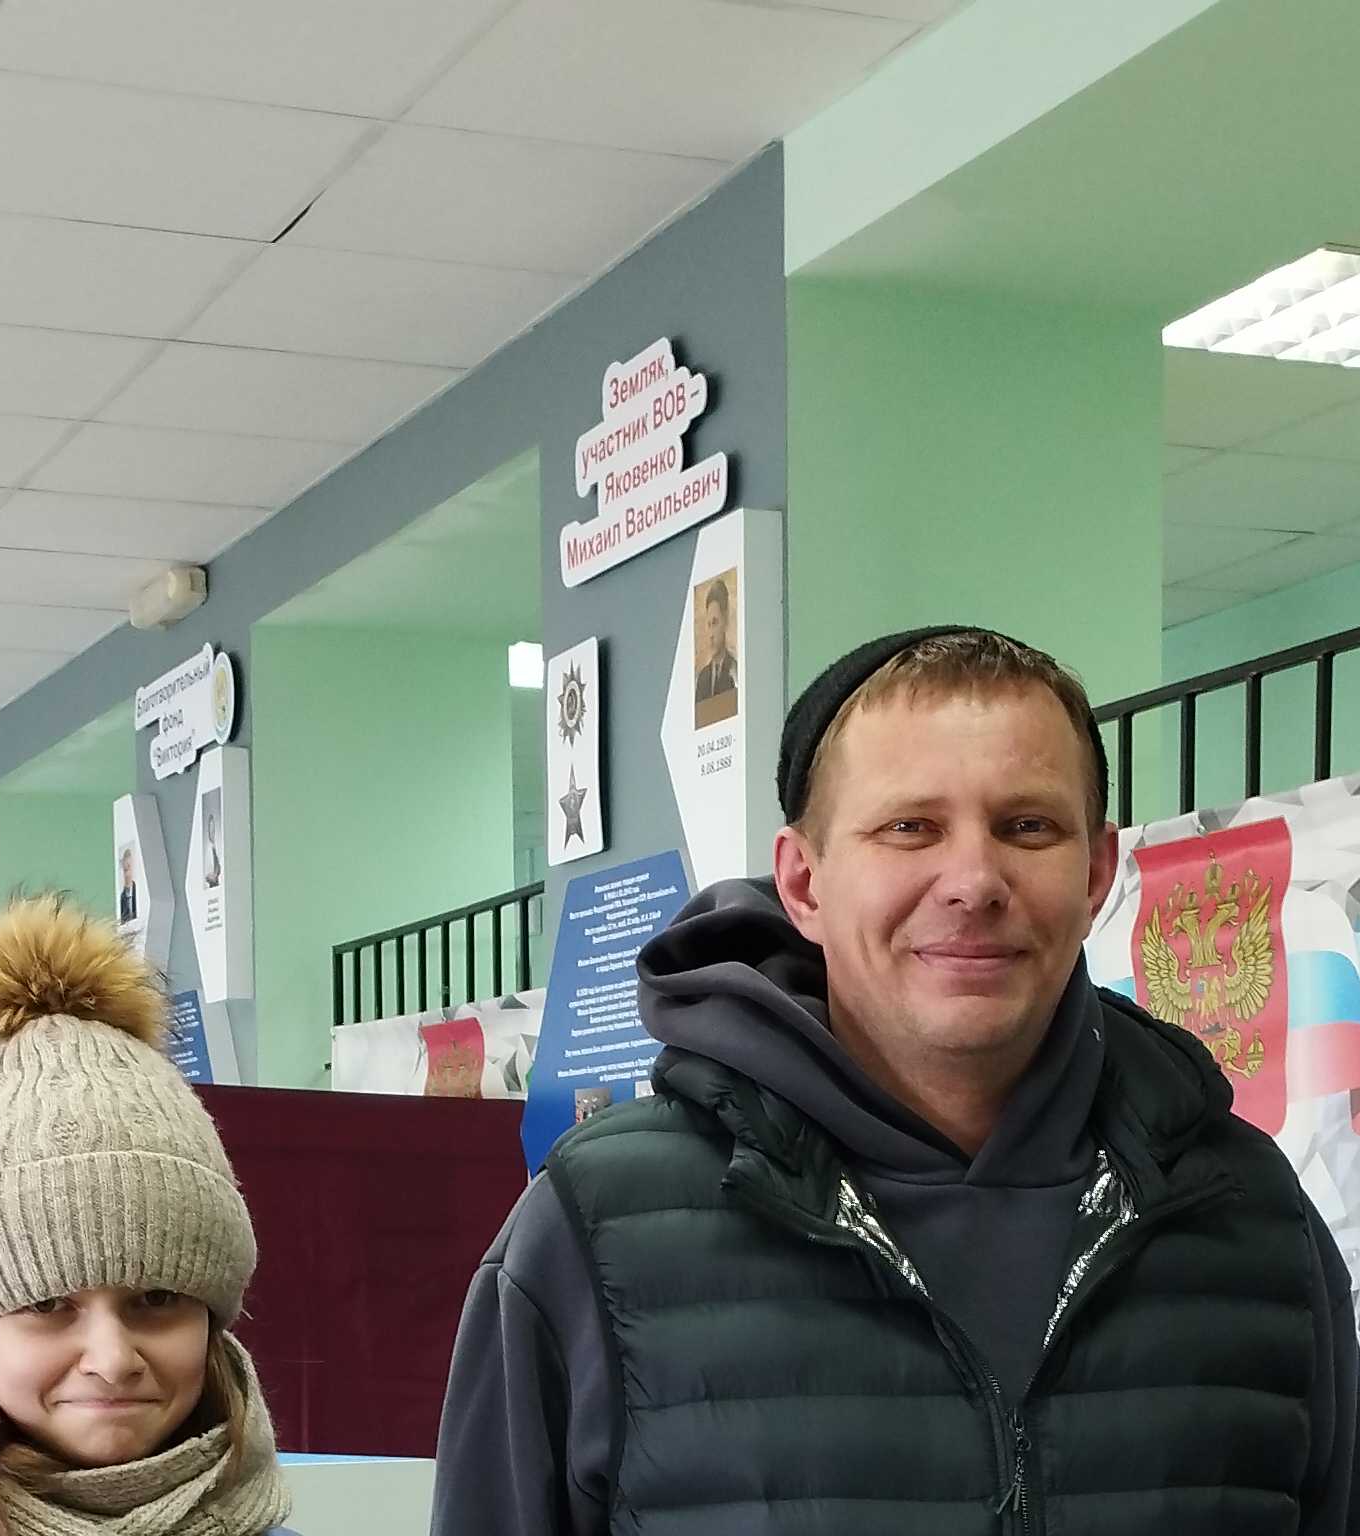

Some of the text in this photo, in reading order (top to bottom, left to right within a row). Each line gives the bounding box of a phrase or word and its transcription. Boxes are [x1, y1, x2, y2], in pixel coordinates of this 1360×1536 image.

[609, 353, 669, 410] Земляк,
[581, 413, 649, 480] участник
[653, 381, 686, 428] ВОВ
[604, 445, 677, 505] Яковенко
[565, 466, 721, 571] Михаил Васильевич
